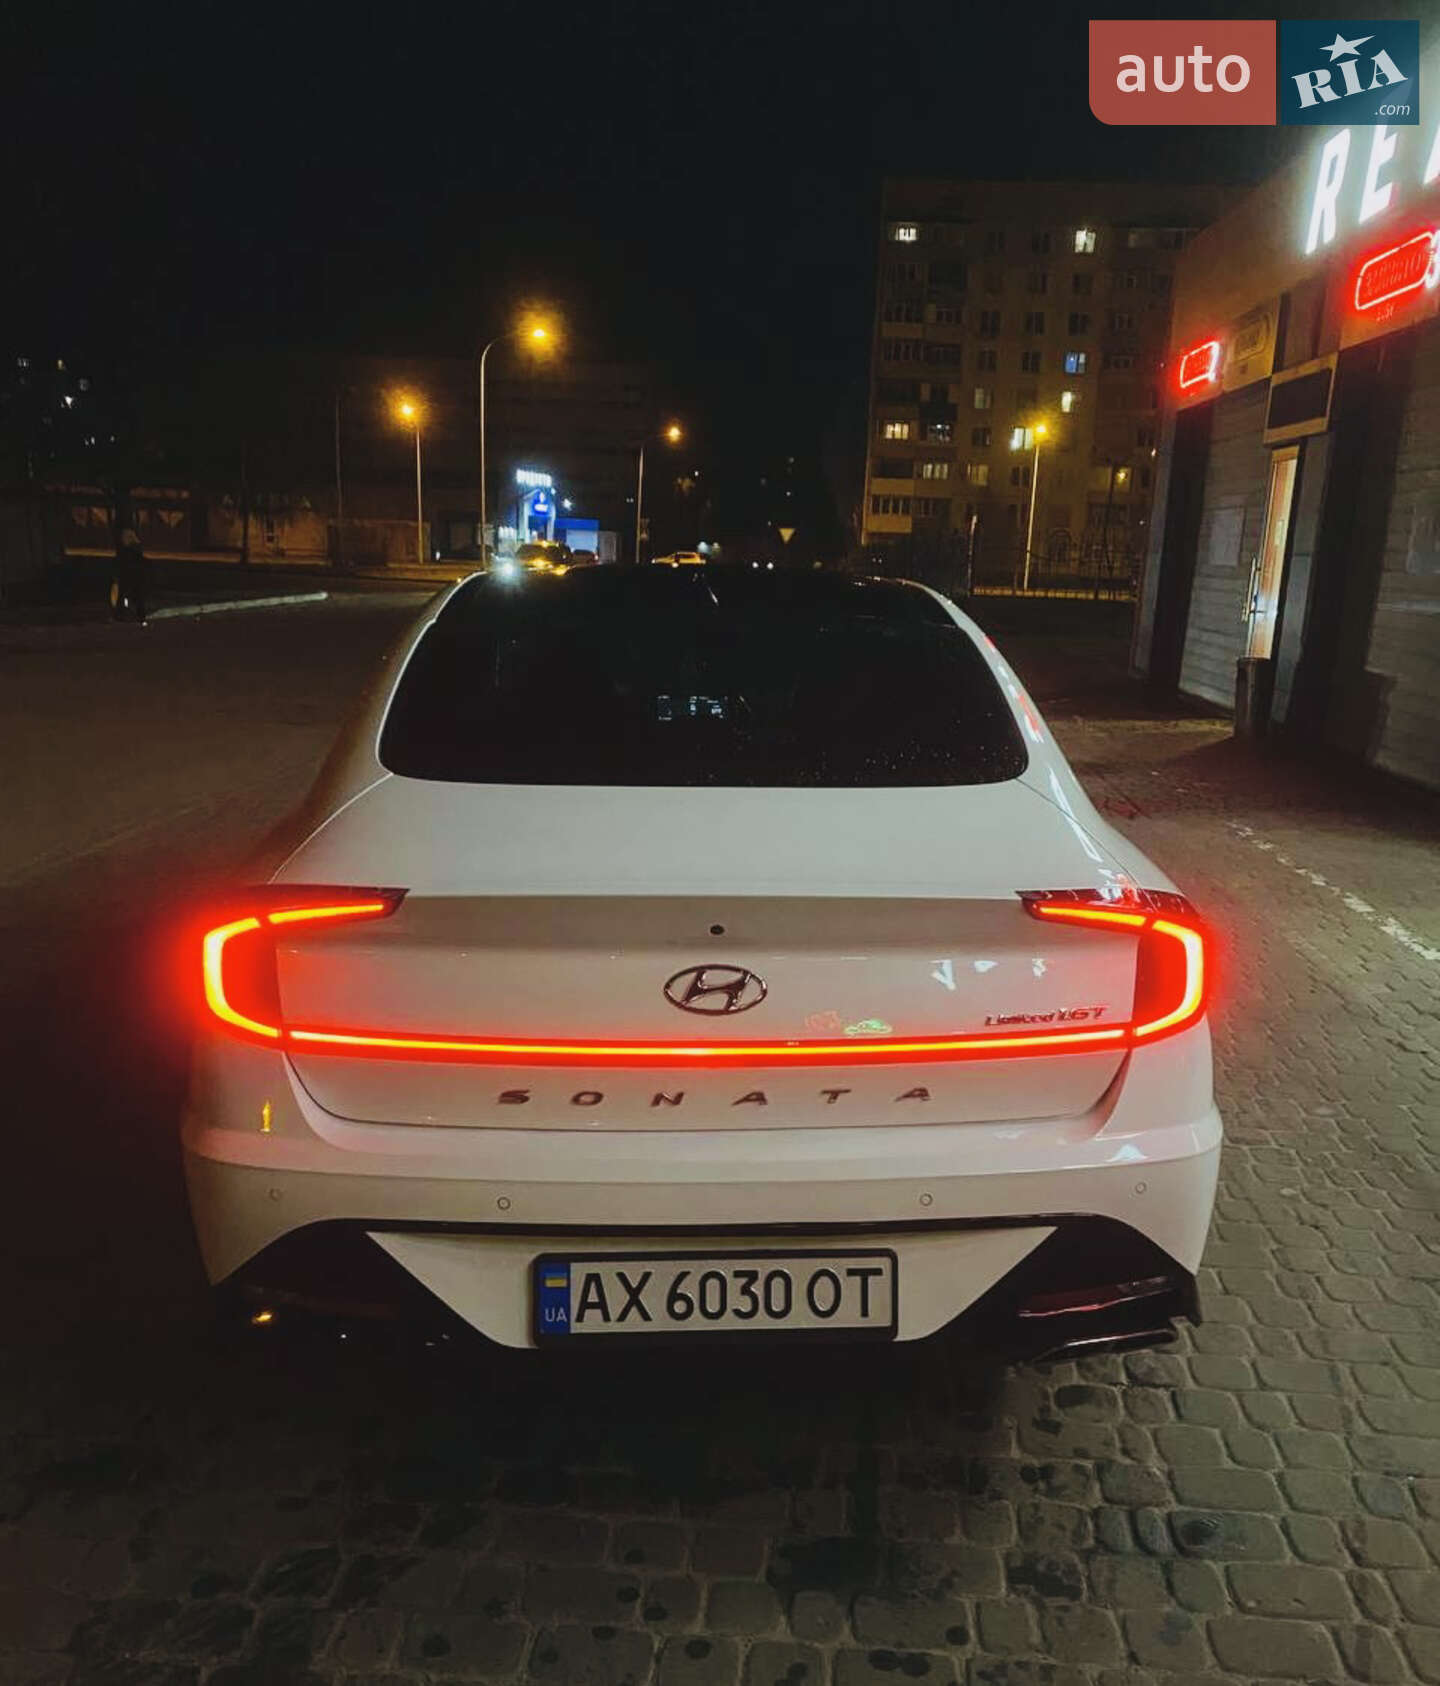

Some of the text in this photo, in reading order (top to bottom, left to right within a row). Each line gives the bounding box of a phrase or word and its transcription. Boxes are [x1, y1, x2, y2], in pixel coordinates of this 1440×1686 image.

[1305, 125, 1440, 255] RE
[498, 1087, 932, 1107] SONATA
[574, 1267, 884, 1323] AX 6030 OT
[545, 1308, 568, 1322] UA
